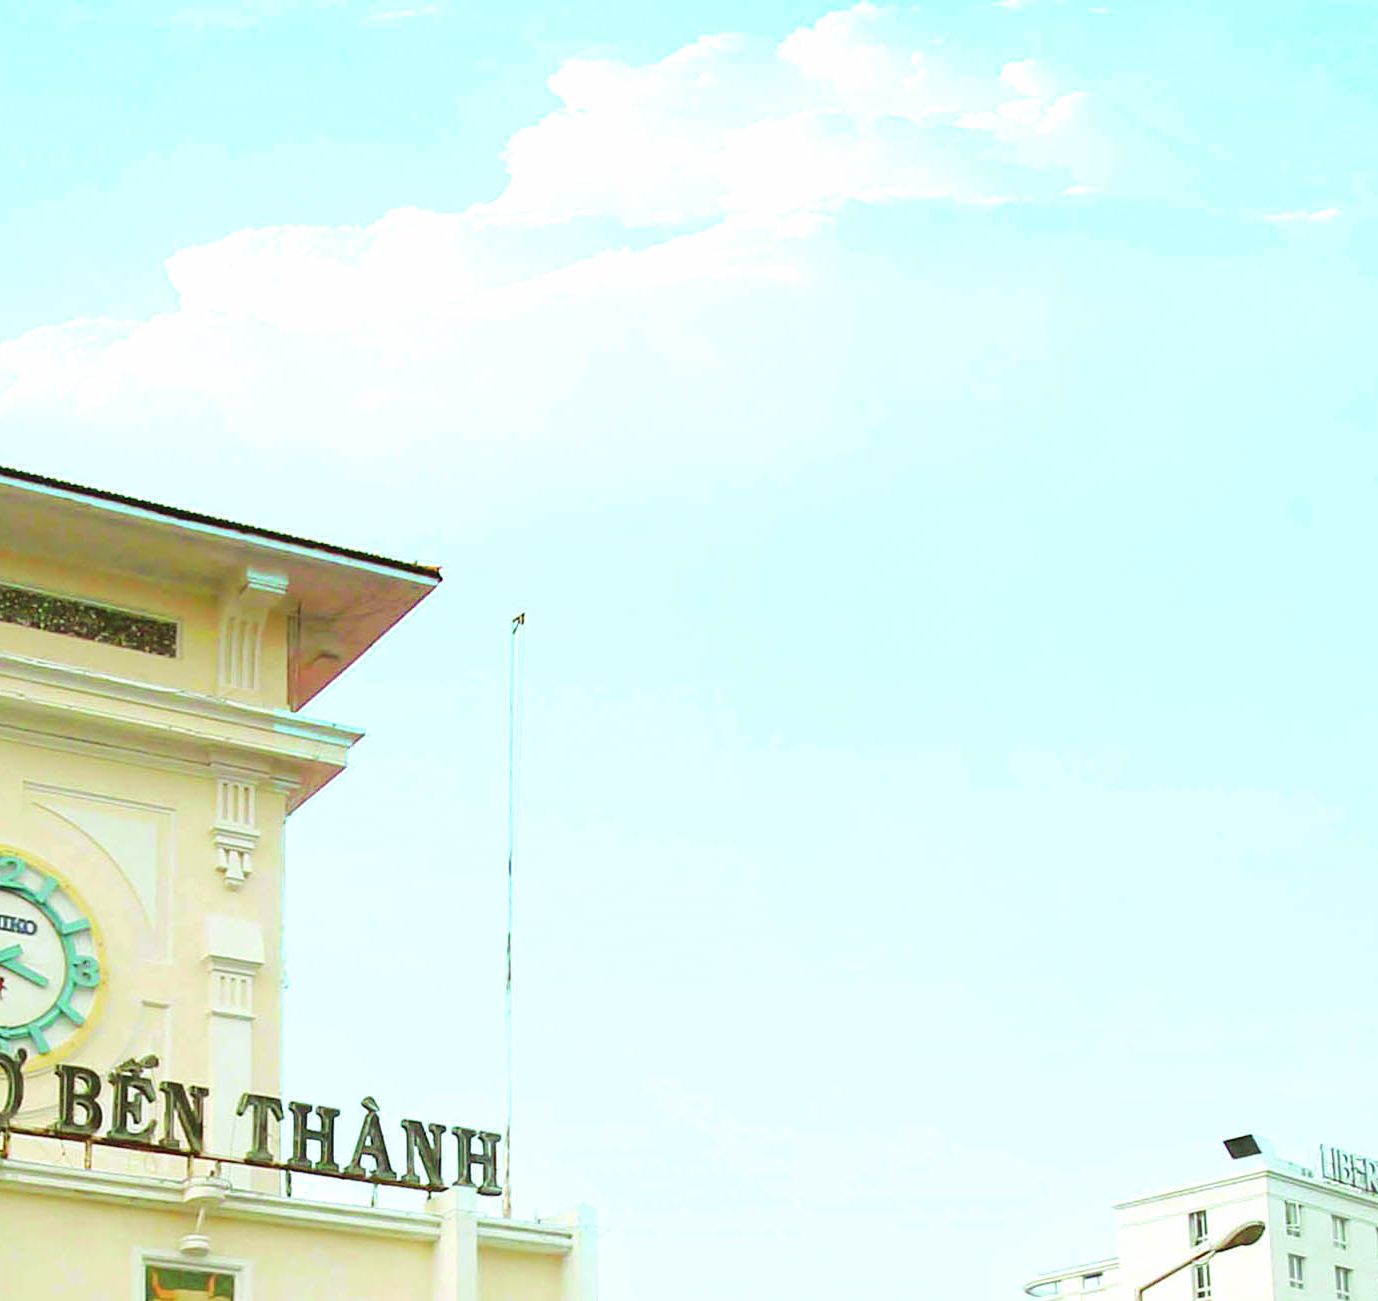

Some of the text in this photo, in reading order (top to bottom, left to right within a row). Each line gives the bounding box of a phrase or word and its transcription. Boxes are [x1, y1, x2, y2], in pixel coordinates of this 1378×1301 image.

[72, 955, 101, 988] 3
[55, 1054, 210, 1154] BẾN
[236, 1096, 503, 1195] THÀNH
